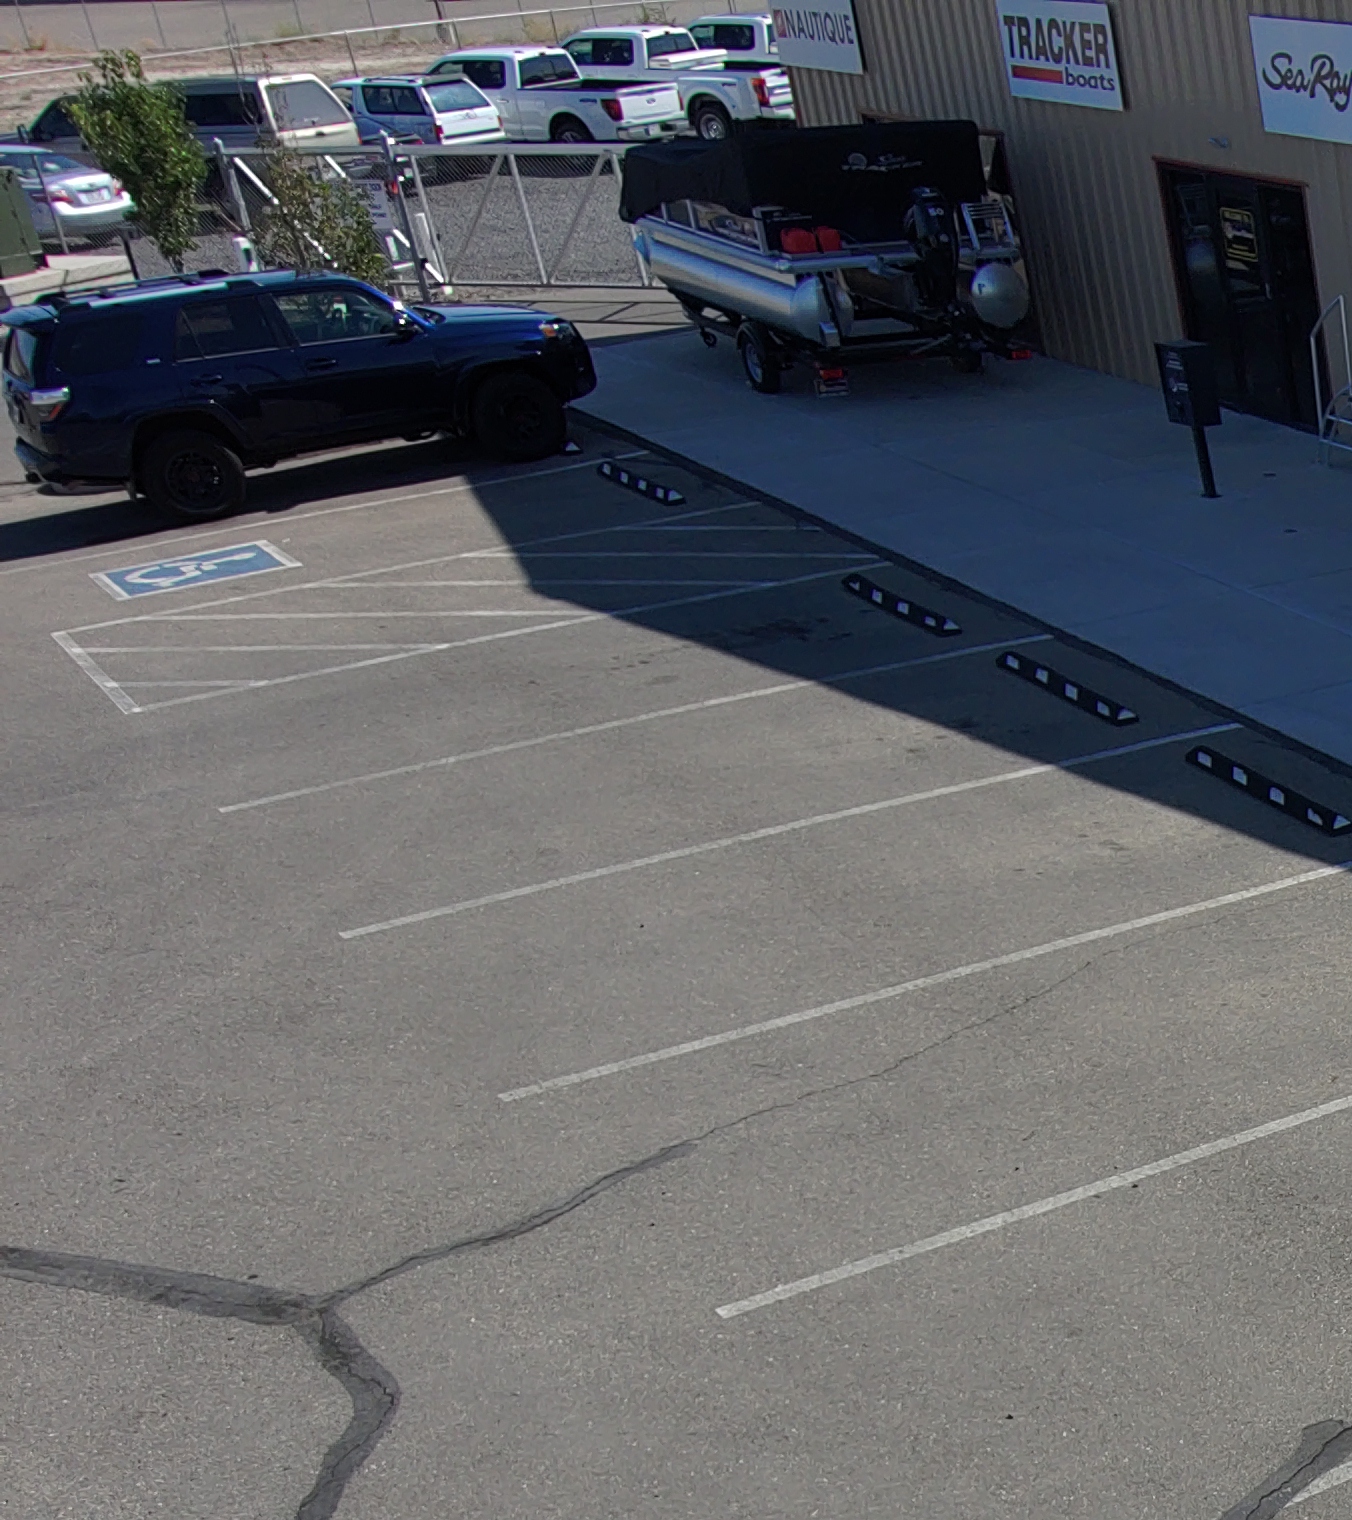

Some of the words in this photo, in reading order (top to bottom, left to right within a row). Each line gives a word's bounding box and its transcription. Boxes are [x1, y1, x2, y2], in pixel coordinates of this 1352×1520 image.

[784, 9, 854, 45] NAUTIQUE
[1003, 15, 1110, 68] TRACKER
[1065, 66, 1115, 91] boats
